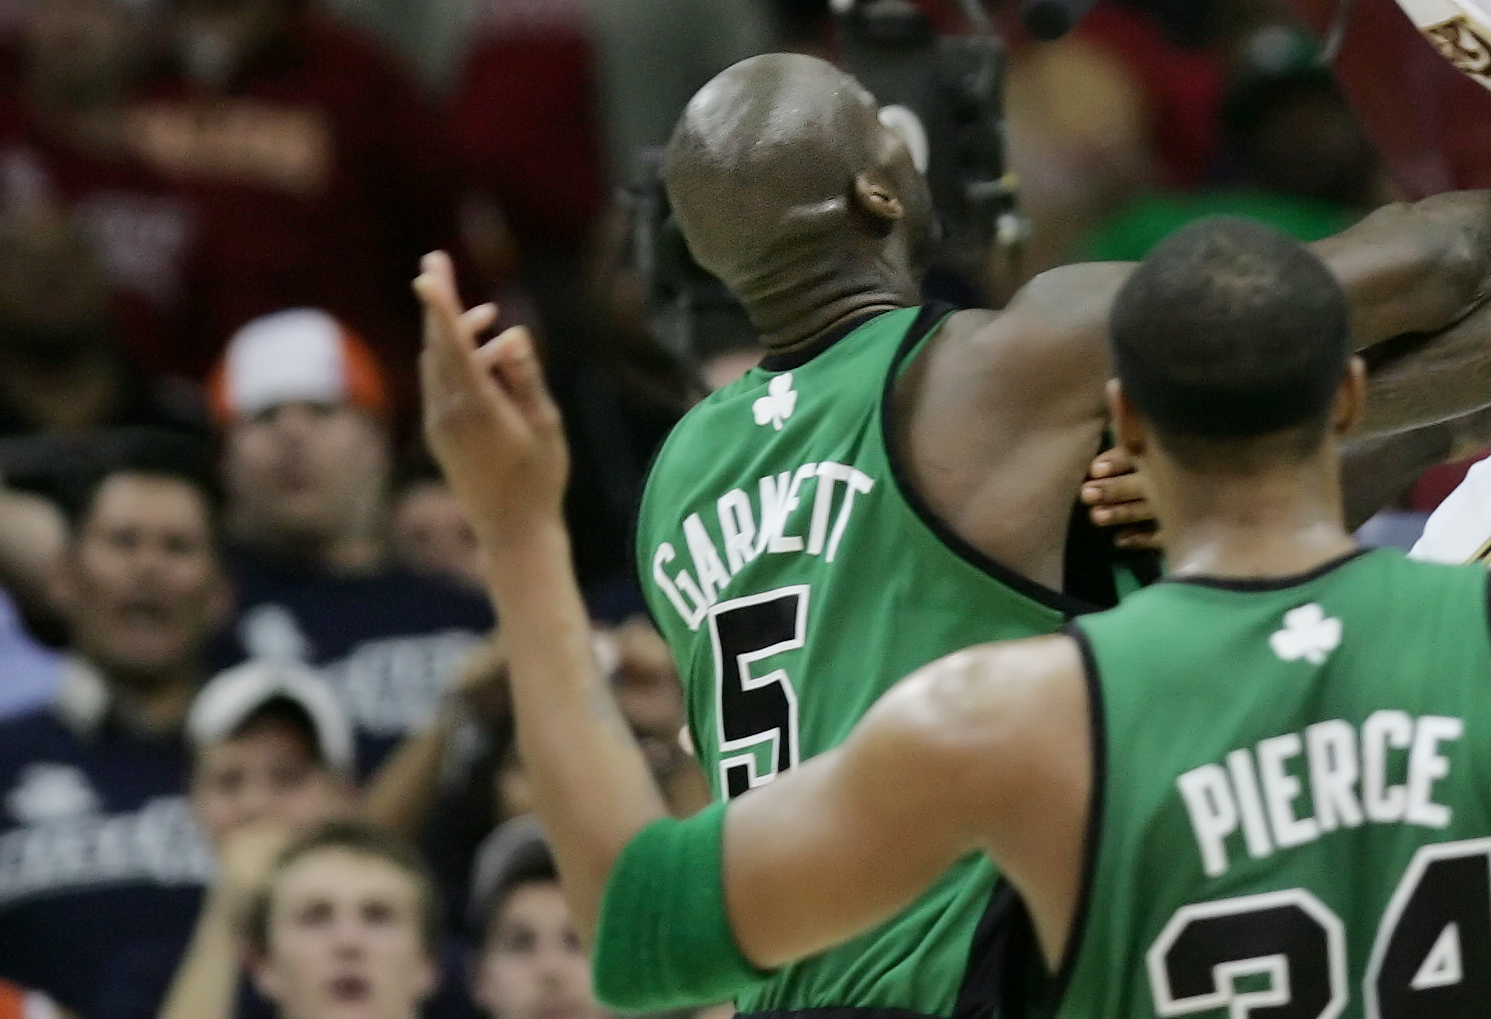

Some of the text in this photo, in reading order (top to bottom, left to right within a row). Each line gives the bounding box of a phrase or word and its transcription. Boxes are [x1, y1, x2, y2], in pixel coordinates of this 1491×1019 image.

[652, 460, 875, 631] GARNETT
[708, 584, 811, 802] 5
[1176, 709, 1464, 877] PIERCE
